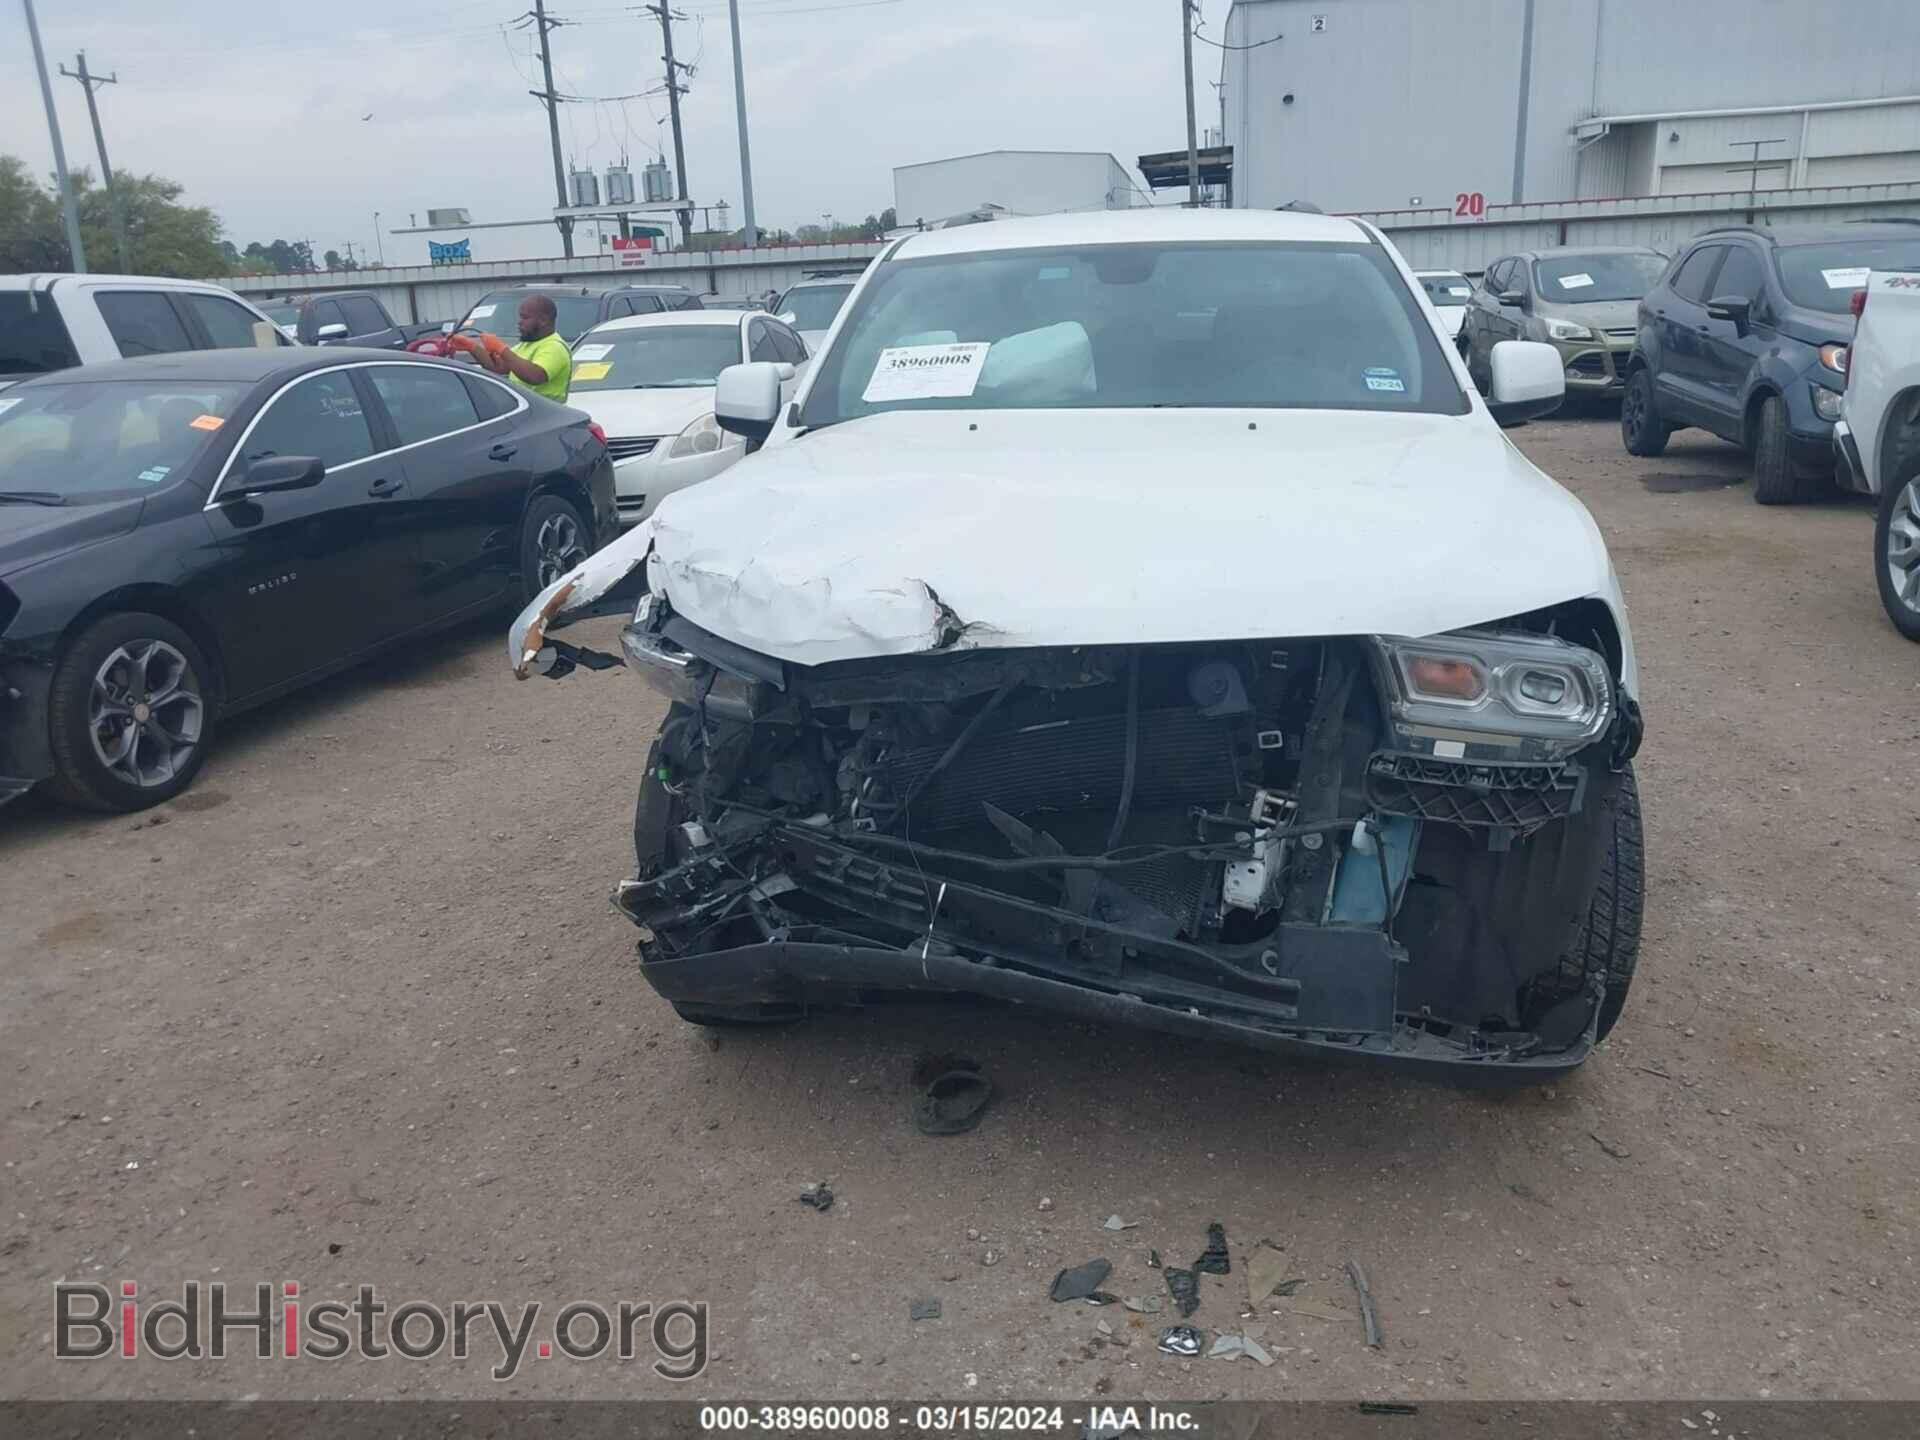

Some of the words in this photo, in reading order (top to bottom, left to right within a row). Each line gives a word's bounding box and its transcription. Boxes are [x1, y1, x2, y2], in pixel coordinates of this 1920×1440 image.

[1314, 19, 1324, 31] 2
[1455, 192, 1484, 217] 20
[888, 353, 973, 370] 38960008
